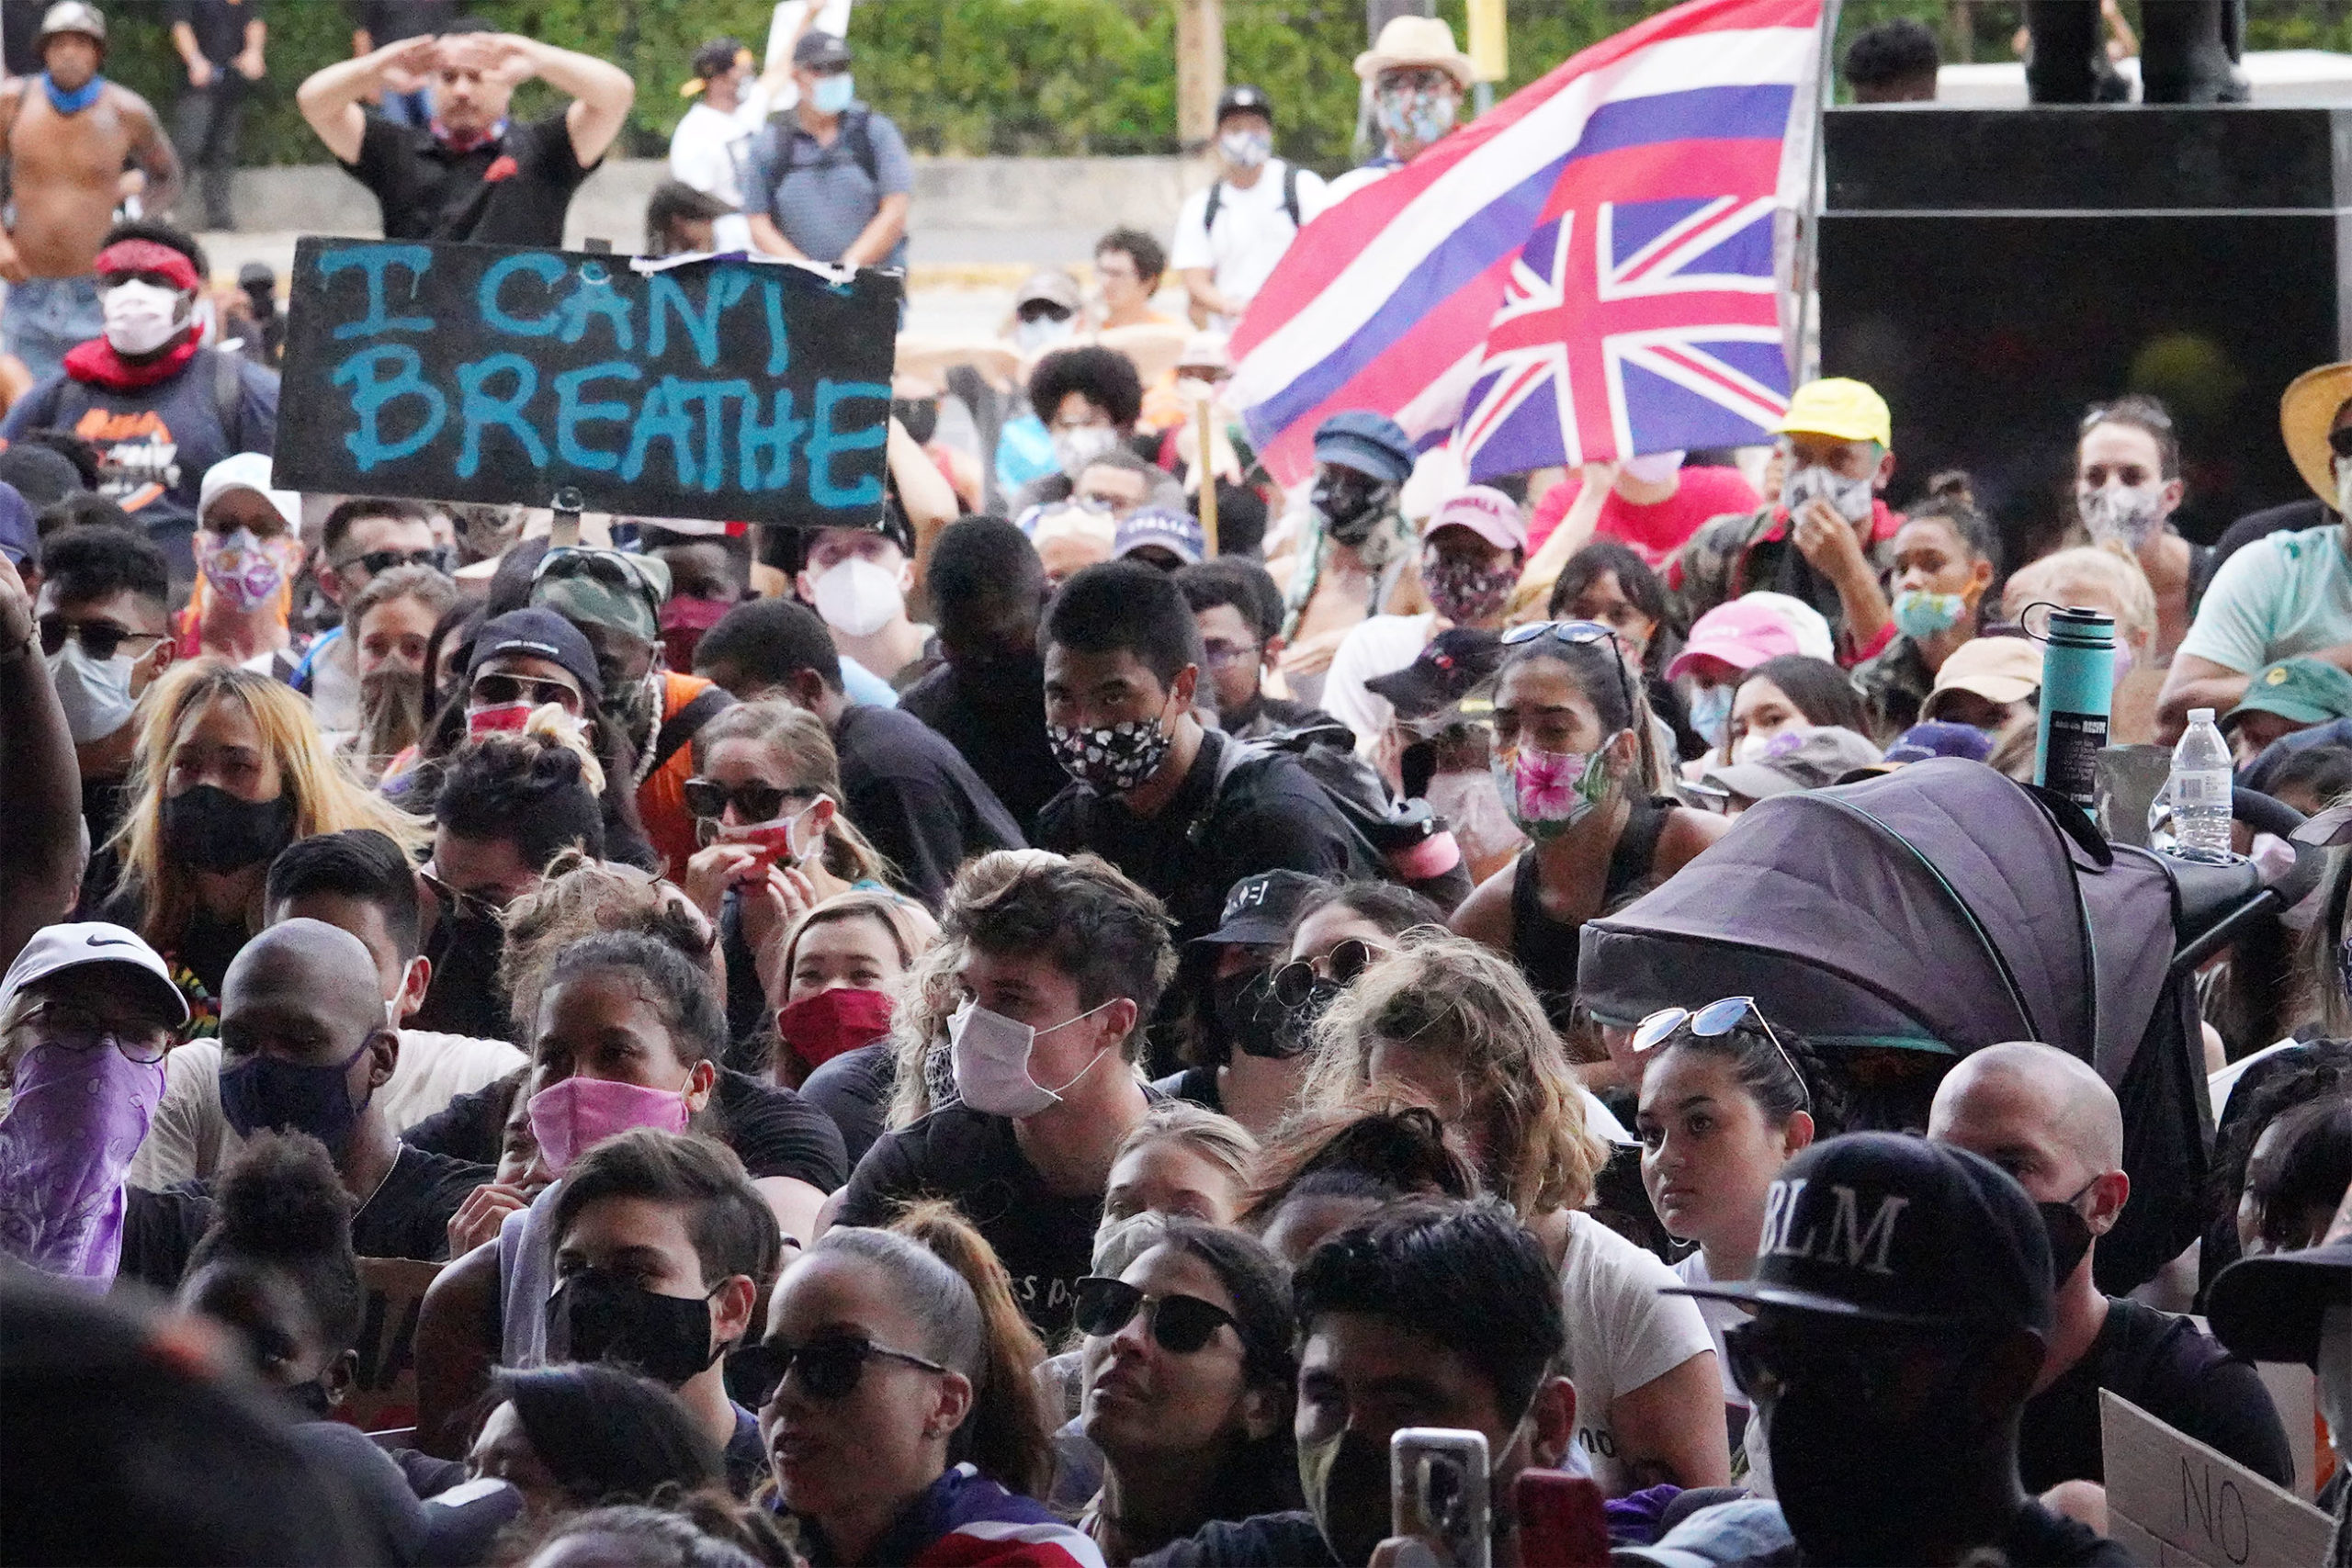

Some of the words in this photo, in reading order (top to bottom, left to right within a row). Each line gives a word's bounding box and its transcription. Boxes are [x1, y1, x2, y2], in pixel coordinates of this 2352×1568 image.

[317, 244, 435, 341] I
[332, 344, 893, 509] BREATHE
[1757, 1178, 1911, 1275] BLM
[2180, 1455, 2250, 1566] NO
